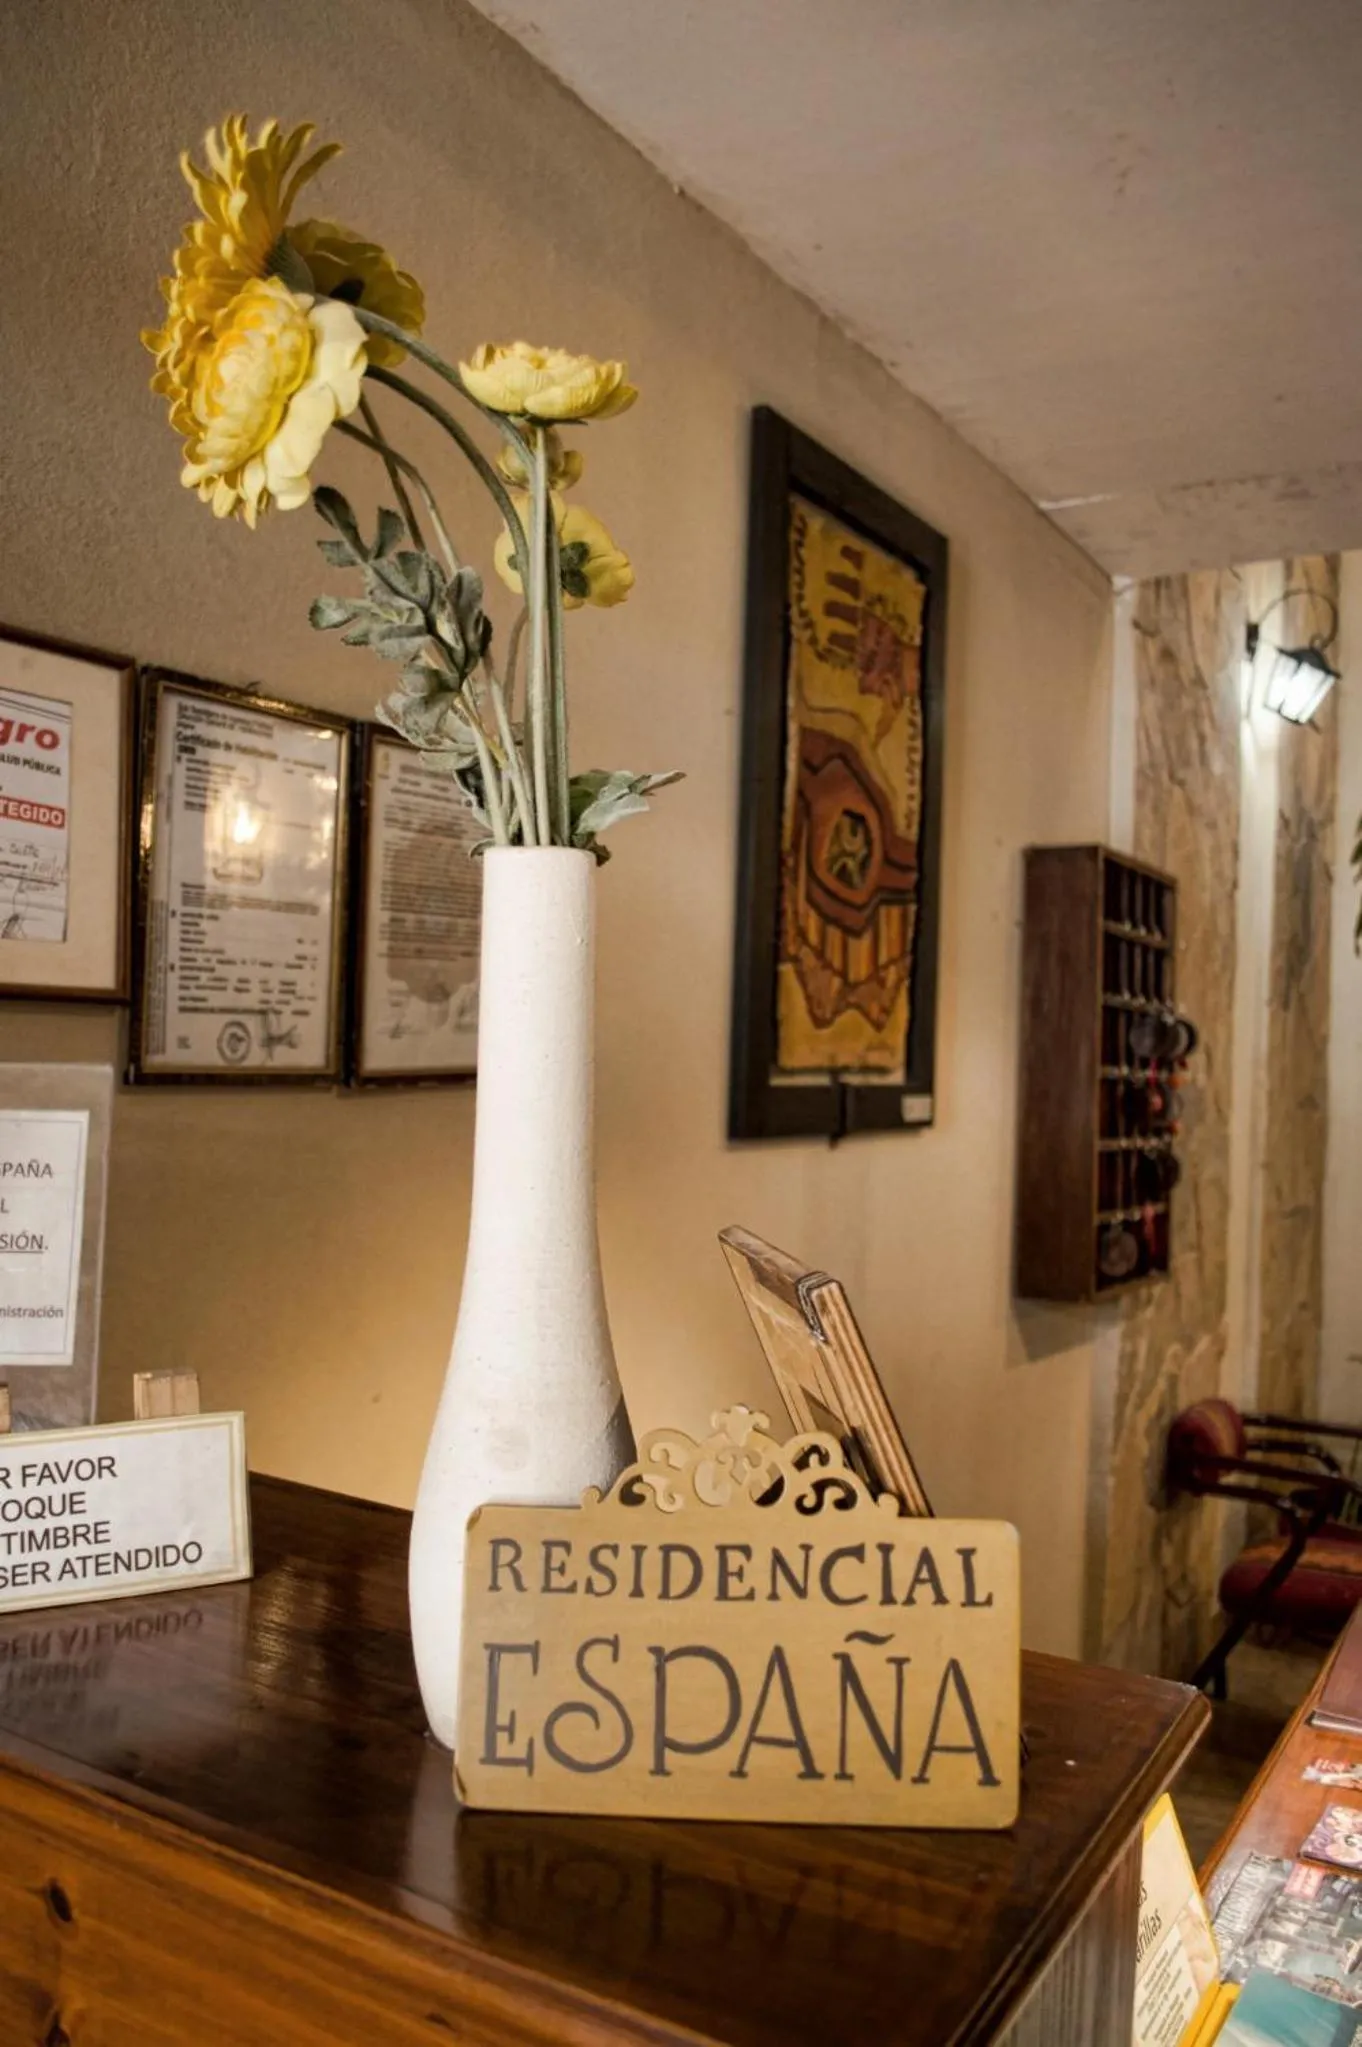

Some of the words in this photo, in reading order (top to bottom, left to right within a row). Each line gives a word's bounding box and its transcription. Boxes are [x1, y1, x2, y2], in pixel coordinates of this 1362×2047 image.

[0, 1159, 53, 1178] PAÑA
[21, 1456, 118, 1487] FAVOR
[0, 1491, 87, 1523] OQUE
[0, 1521, 111, 1556] TIMBRE
[57, 1541, 203, 1582] ATENDIDO
[487, 1537, 993, 1608] RESIDENCIAL
[480, 1630, 1001, 1787] ESPAÑA
